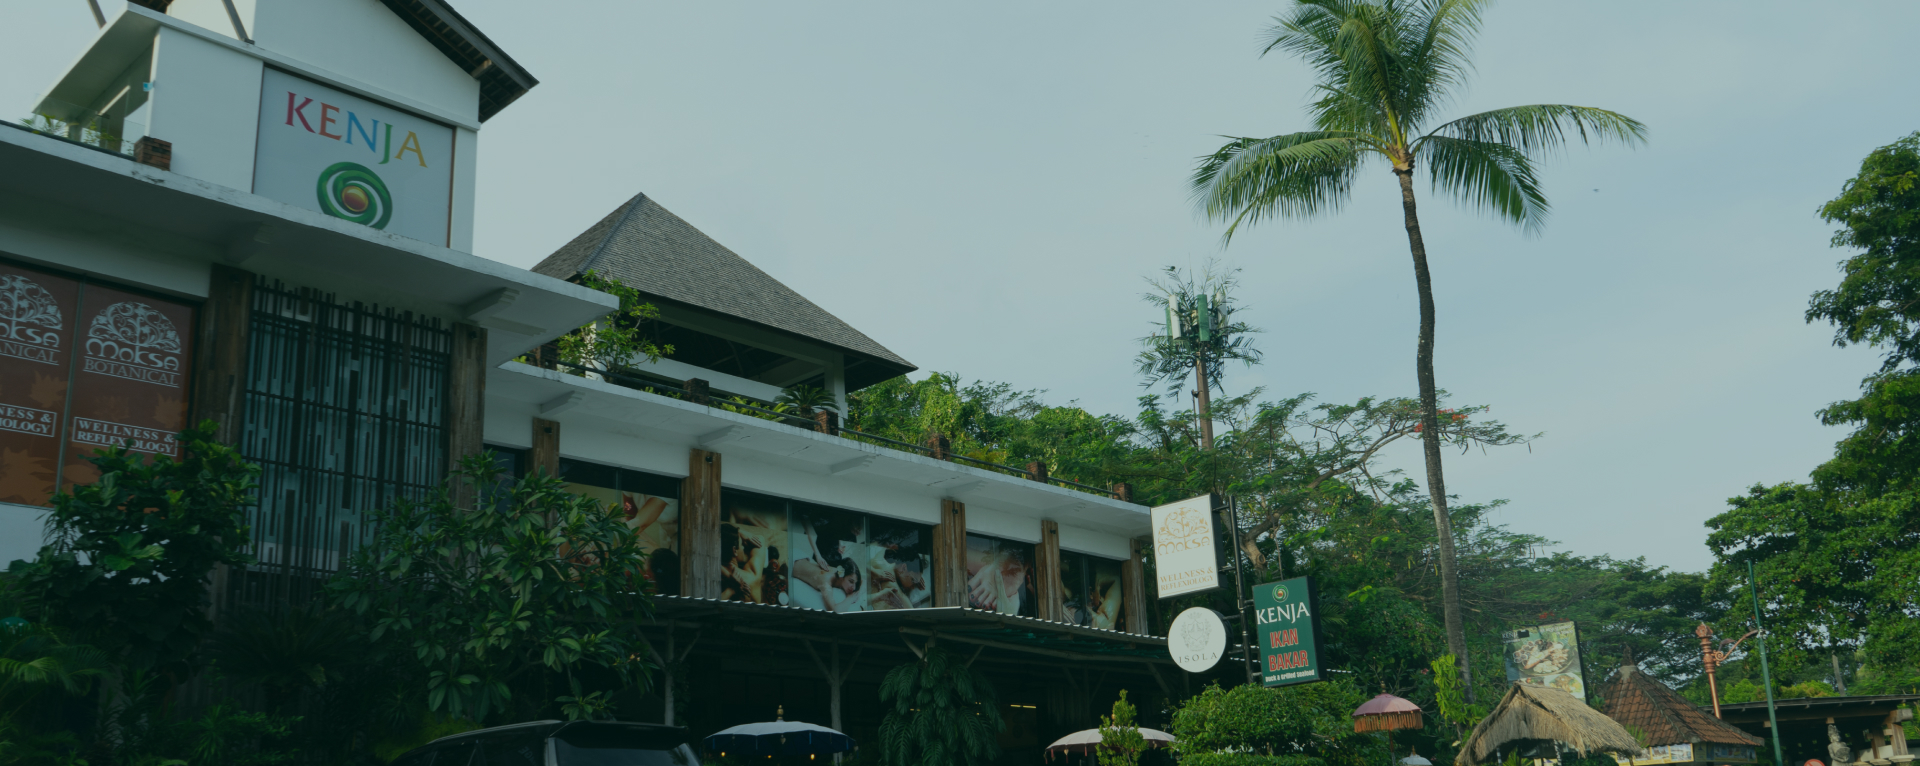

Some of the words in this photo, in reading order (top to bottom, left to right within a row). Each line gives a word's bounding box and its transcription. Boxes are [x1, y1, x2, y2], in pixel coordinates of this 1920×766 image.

[285, 91, 428, 168] KENJA
[0, 342, 59, 363] NICAL
[84, 360, 179, 386] BOTANICAL
[40, 413, 52, 423] &
[77, 430, 174, 453] REFLEXOLOGY
[78, 420, 159, 440] WELLNESS
[164, 433, 174, 443] &
[1160, 568, 1205, 583] WELLNESS
[1206, 566, 1214, 574] &
[1256, 602, 1310, 624] KENJA
[1270, 628, 1299, 648] IKAN
[1179, 652, 1218, 663] ISOLA
[1268, 650, 1309, 672] BAKAR
